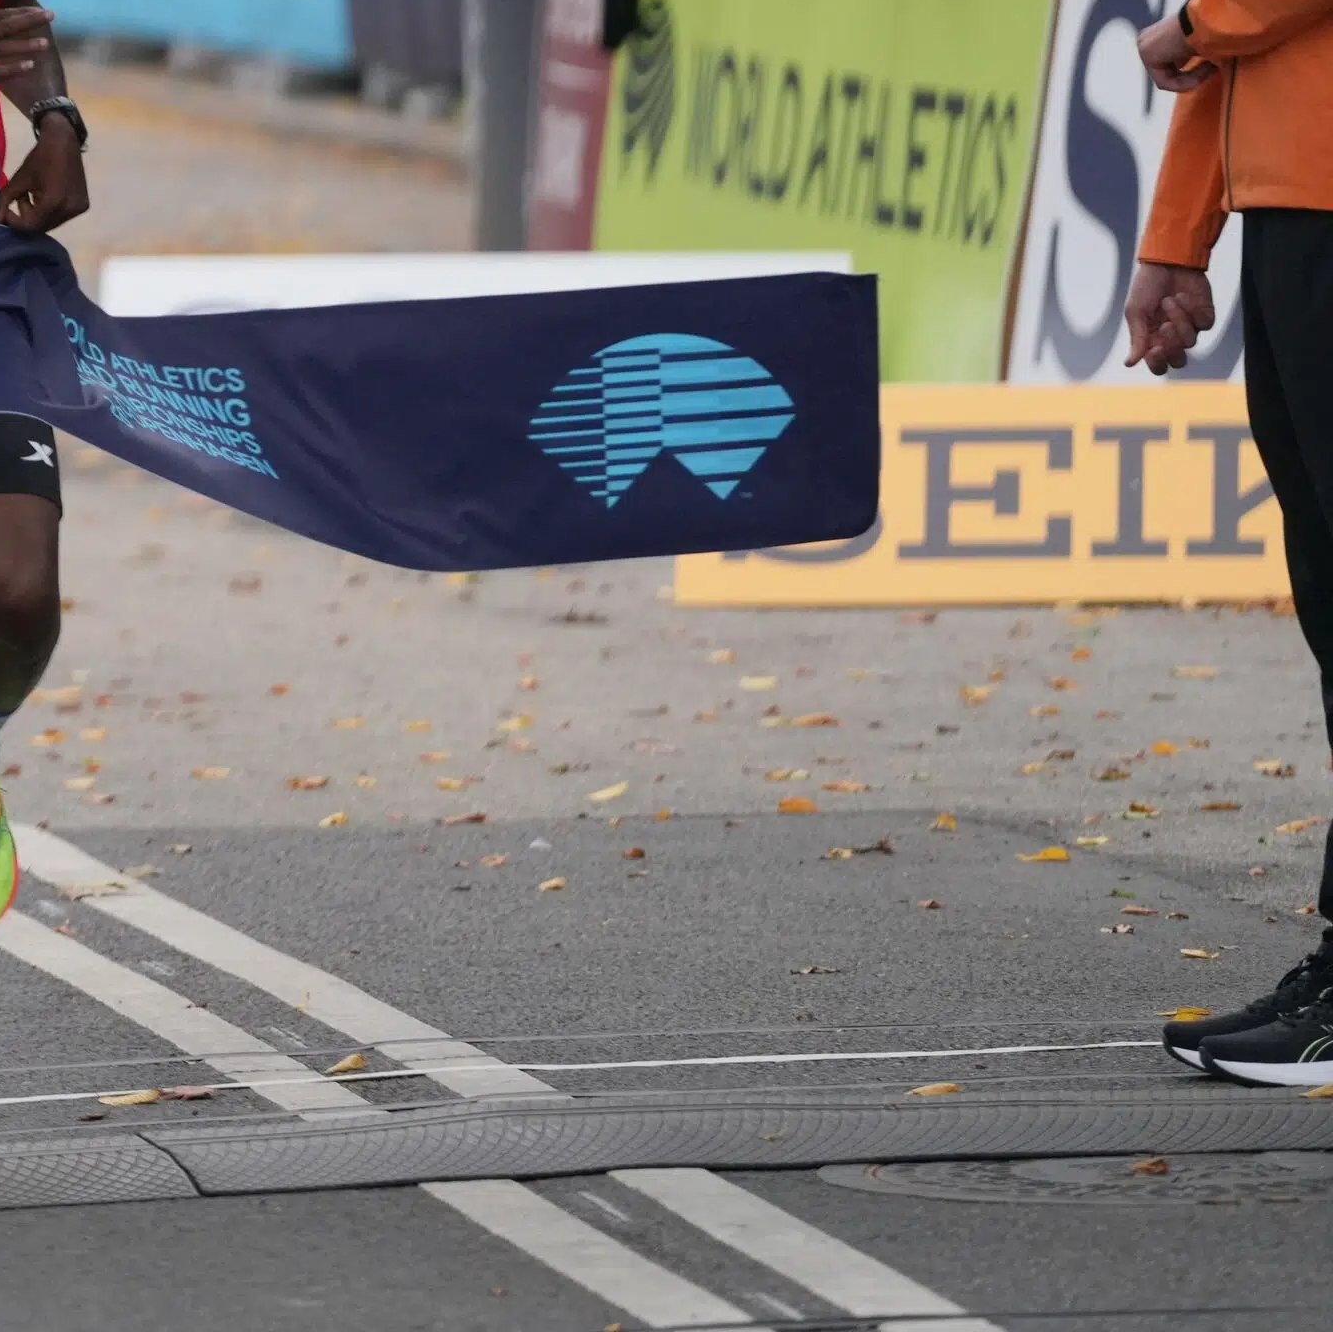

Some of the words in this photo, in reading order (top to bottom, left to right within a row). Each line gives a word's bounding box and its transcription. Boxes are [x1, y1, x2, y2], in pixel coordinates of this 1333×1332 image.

[685, 44, 802, 201] WORLD
[796, 70, 1017, 249] ATHLETICS
[110, 351, 246, 394] ATHLETICS
[116, 373, 252, 427] RUNNING
[719, 424, 1277, 561] EIK
